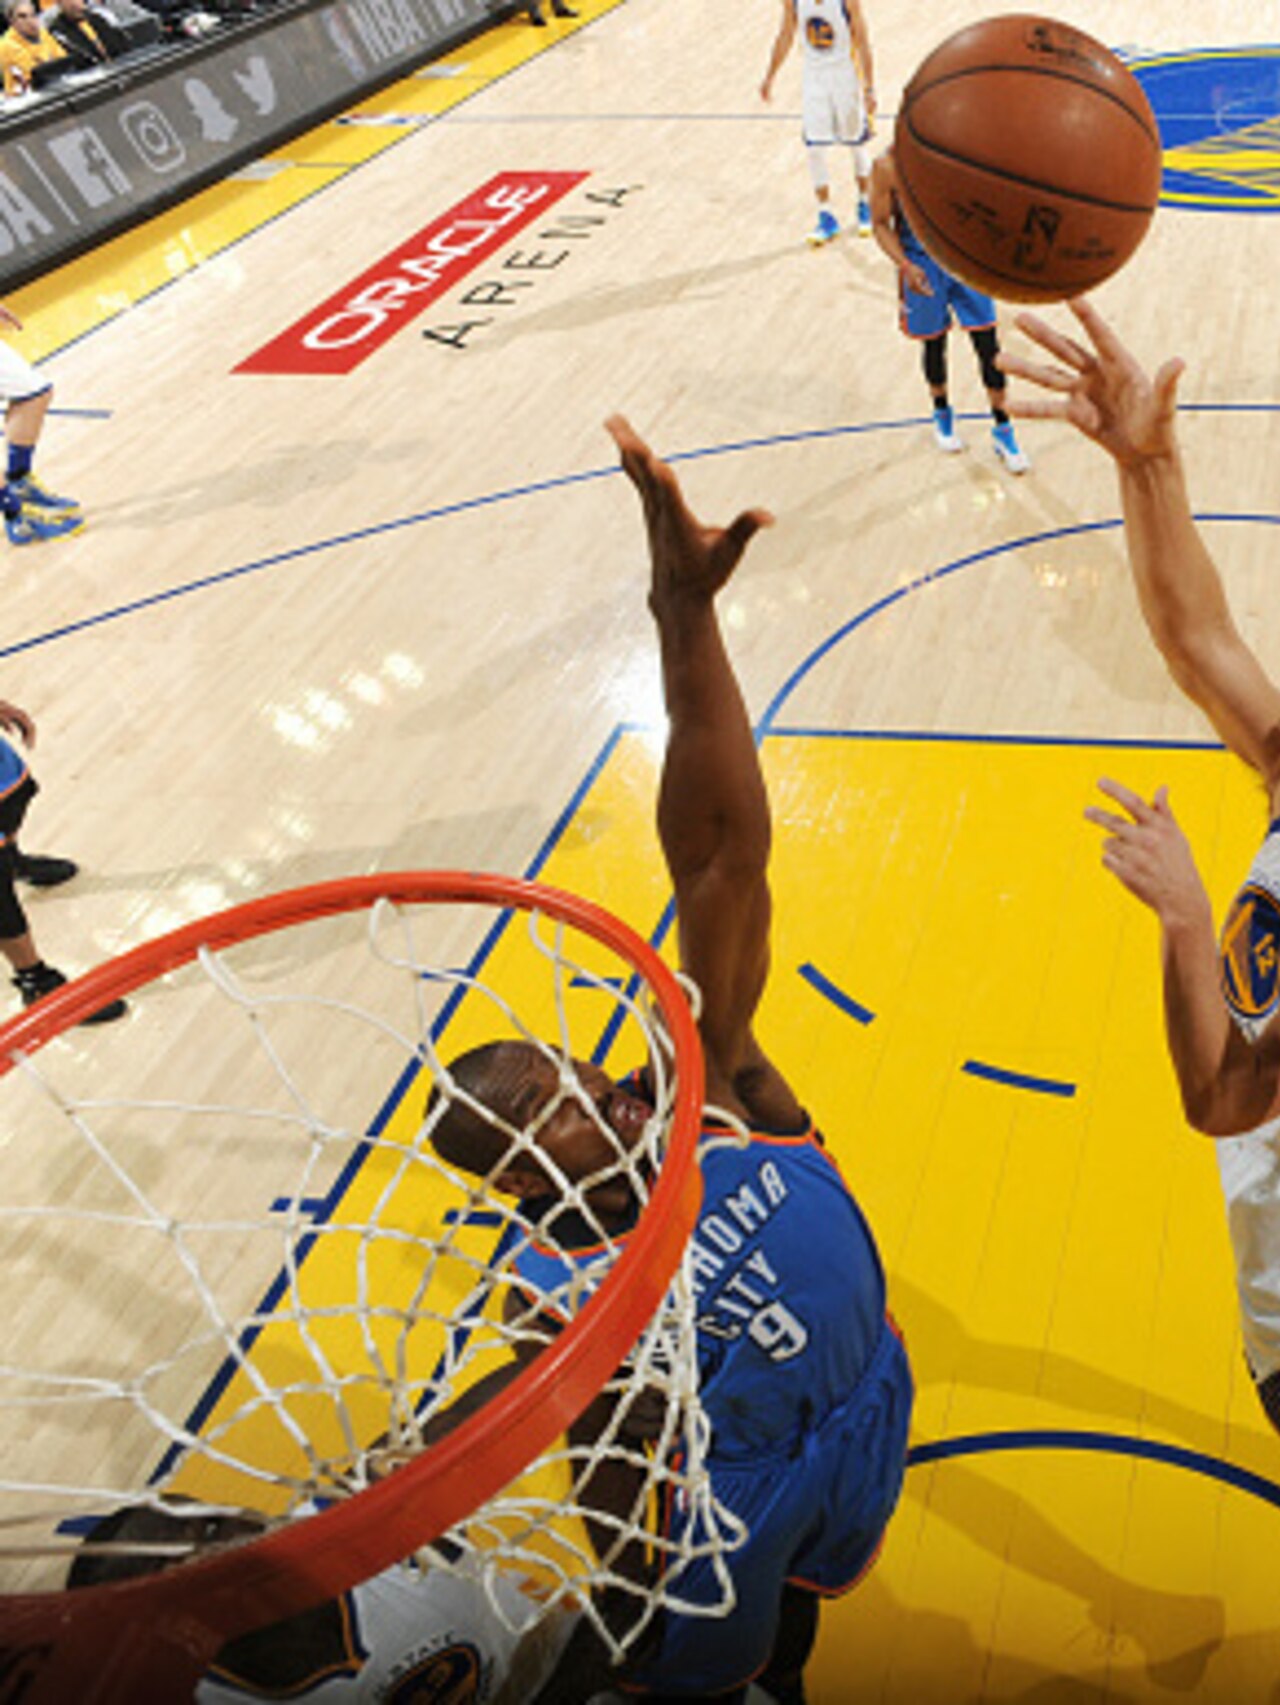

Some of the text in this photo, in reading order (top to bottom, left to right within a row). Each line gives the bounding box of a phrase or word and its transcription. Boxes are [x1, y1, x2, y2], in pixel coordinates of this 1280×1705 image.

[346, 0, 428, 63] NBA
[303, 184, 549, 349] ORACLE
[422, 184, 645, 349] ARENA
[697, 1248, 778, 1341] CITY
[748, 1301, 809, 1362] 9
